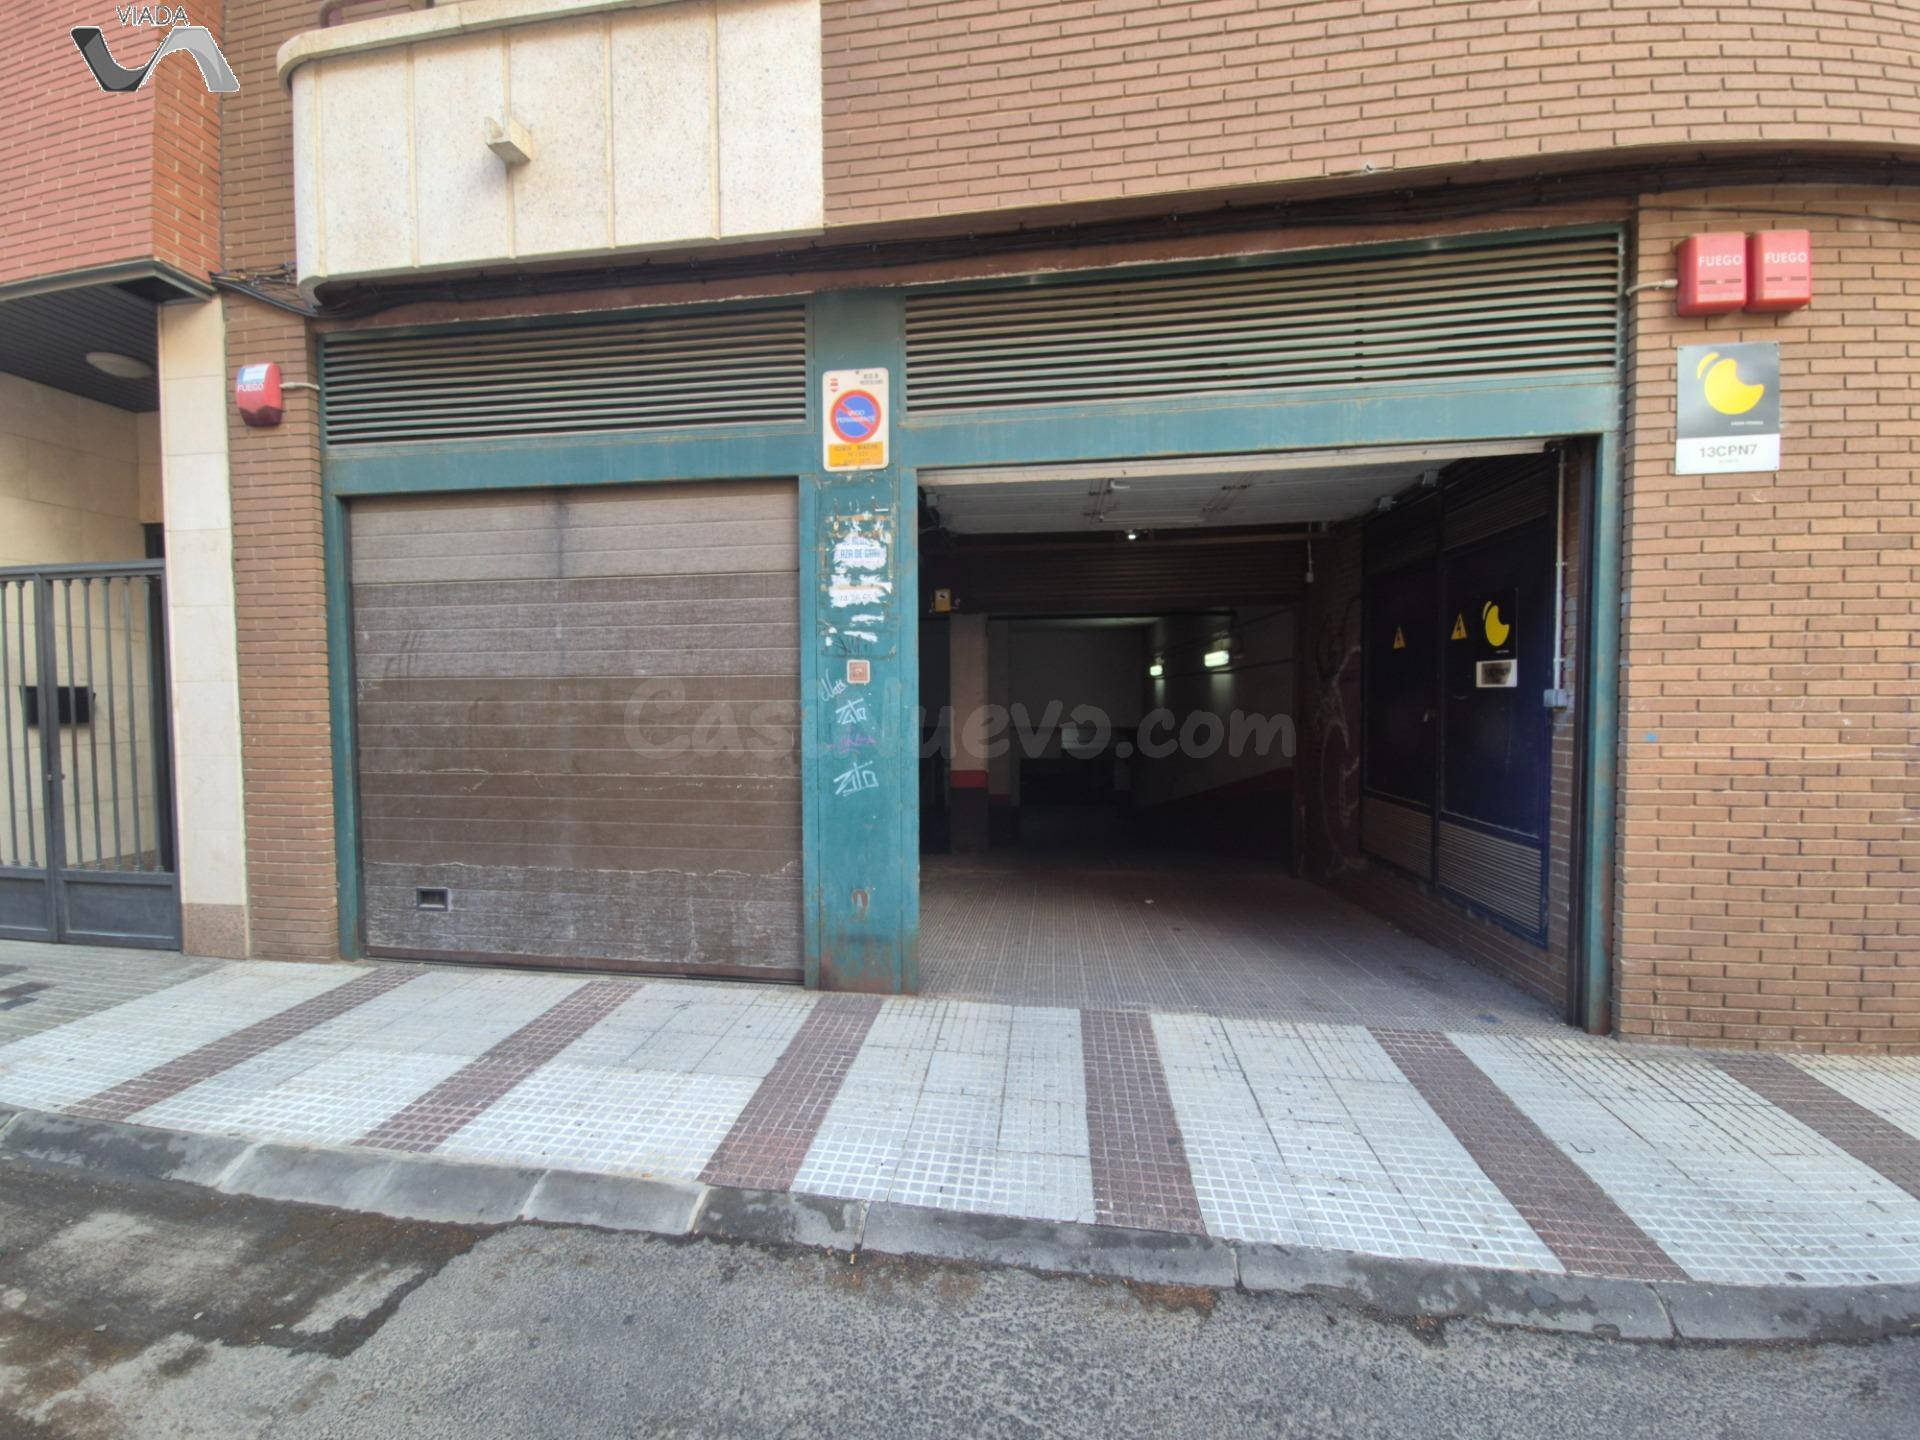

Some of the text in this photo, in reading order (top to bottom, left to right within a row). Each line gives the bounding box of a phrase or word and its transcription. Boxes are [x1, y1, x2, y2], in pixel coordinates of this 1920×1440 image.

[1698, 254, 1743, 267] FUEGO
[1764, 251, 1808, 264] FUEGO
[237, 383, 264, 392] FUEGO
[1699, 444, 1758, 458] 13CPN7
